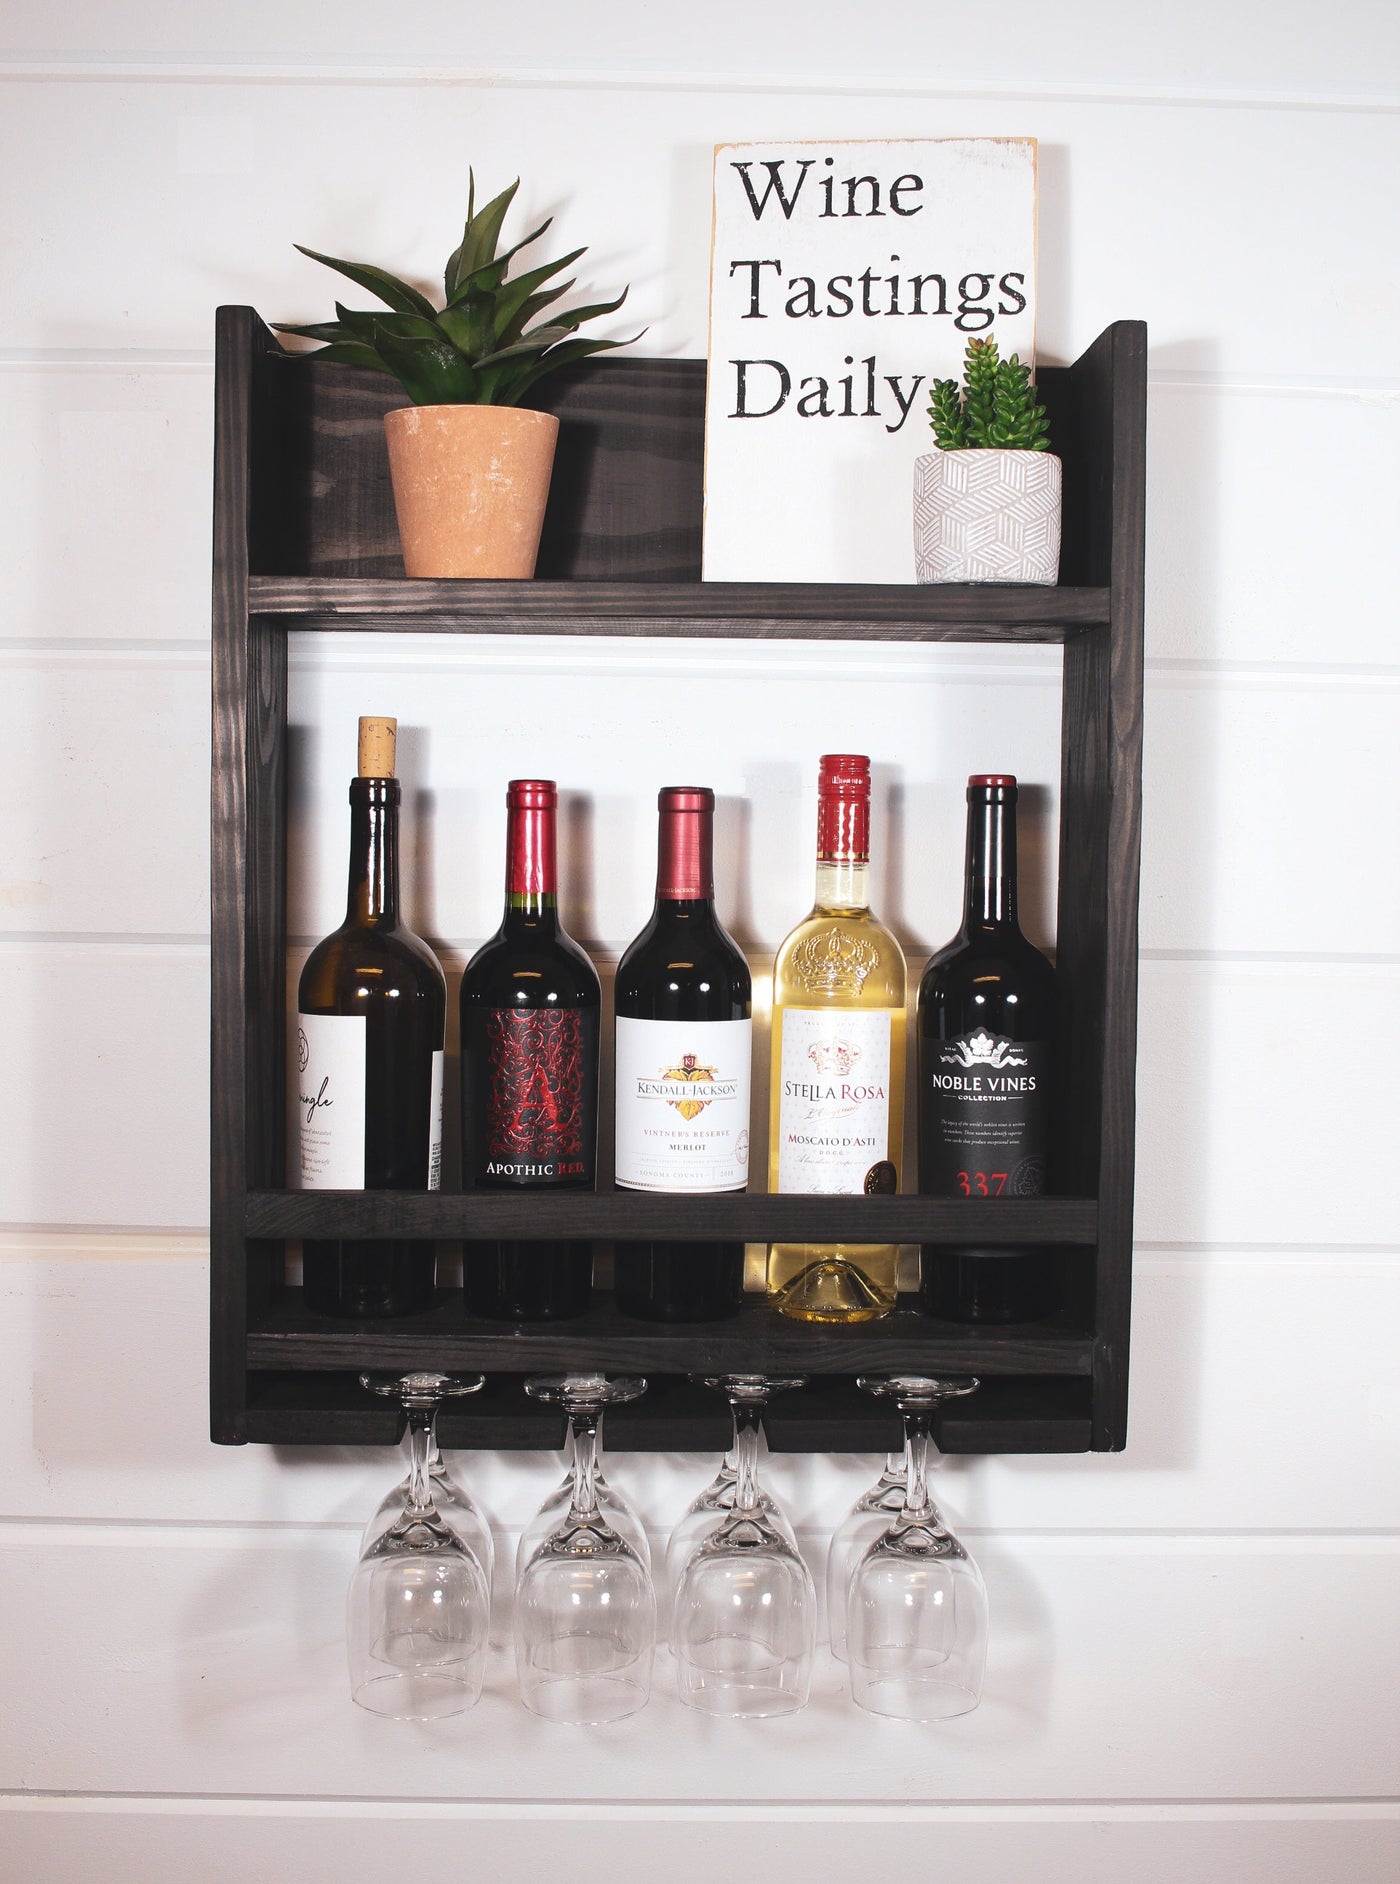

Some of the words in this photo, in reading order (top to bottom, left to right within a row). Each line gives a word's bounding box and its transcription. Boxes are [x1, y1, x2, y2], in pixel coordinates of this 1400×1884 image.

[730, 157, 924, 221] Wine
[729, 255, 1027, 332] Tastings
[727, 356, 926, 433] Daily
[638, 1082, 736, 1096] KENDALL-JACKSON
[933, 1074, 982, 1091] NOBLE
[987, 1076, 1036, 1092] VINES
[785, 1081, 836, 1102] STELLA
[841, 1084, 885, 1104] ROSA
[643, 1129, 689, 1138] VINTNER'S
[693, 1129, 730, 1138] RESERVE
[788, 1134, 840, 1146] MOSCATO
[843, 1137, 876, 1147] D'ASTI
[487, 1162, 553, 1176] APOTHIC
[639, 1169, 670, 1178] SONOMA
[673, 1170, 704, 1178] COUNTY
[956, 1171, 1008, 1197] 337
